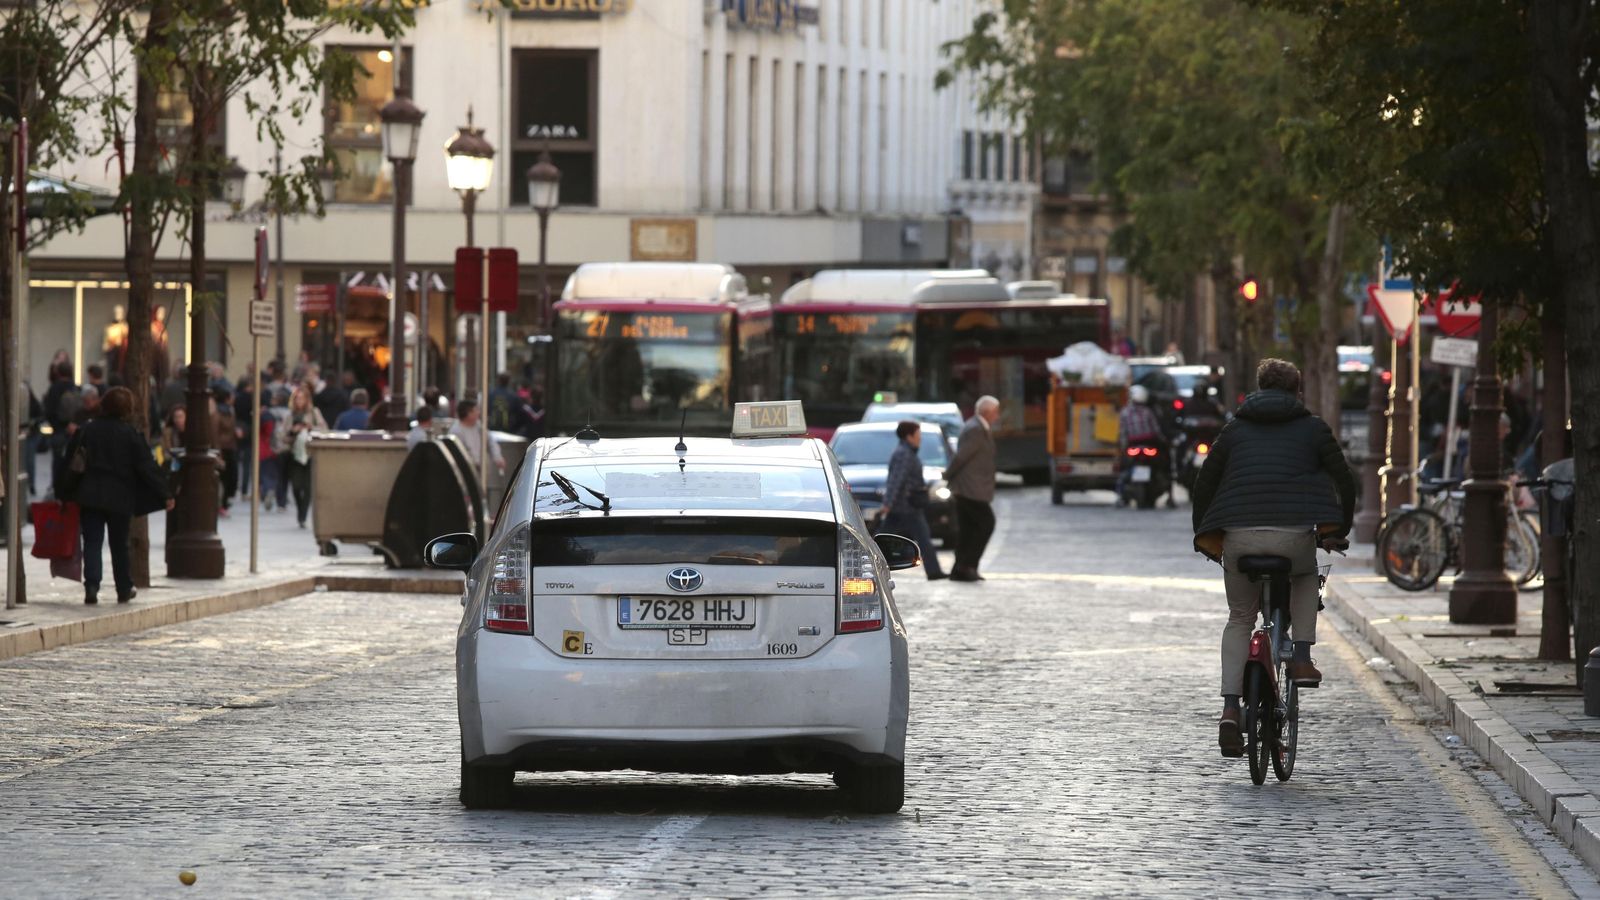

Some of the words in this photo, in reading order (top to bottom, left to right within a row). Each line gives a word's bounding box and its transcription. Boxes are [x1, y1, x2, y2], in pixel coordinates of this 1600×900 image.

[527, 124, 578, 138] ZARA
[586, 315, 609, 337] 27
[751, 407, 787, 426] TAXI
[640, 600, 694, 621] 7628
[704, 600, 745, 621] HHJ
[672, 629, 703, 642] SP
[564, 635, 580, 652] C
[584, 642, 594, 655] E
[767, 643, 798, 655] 1609
